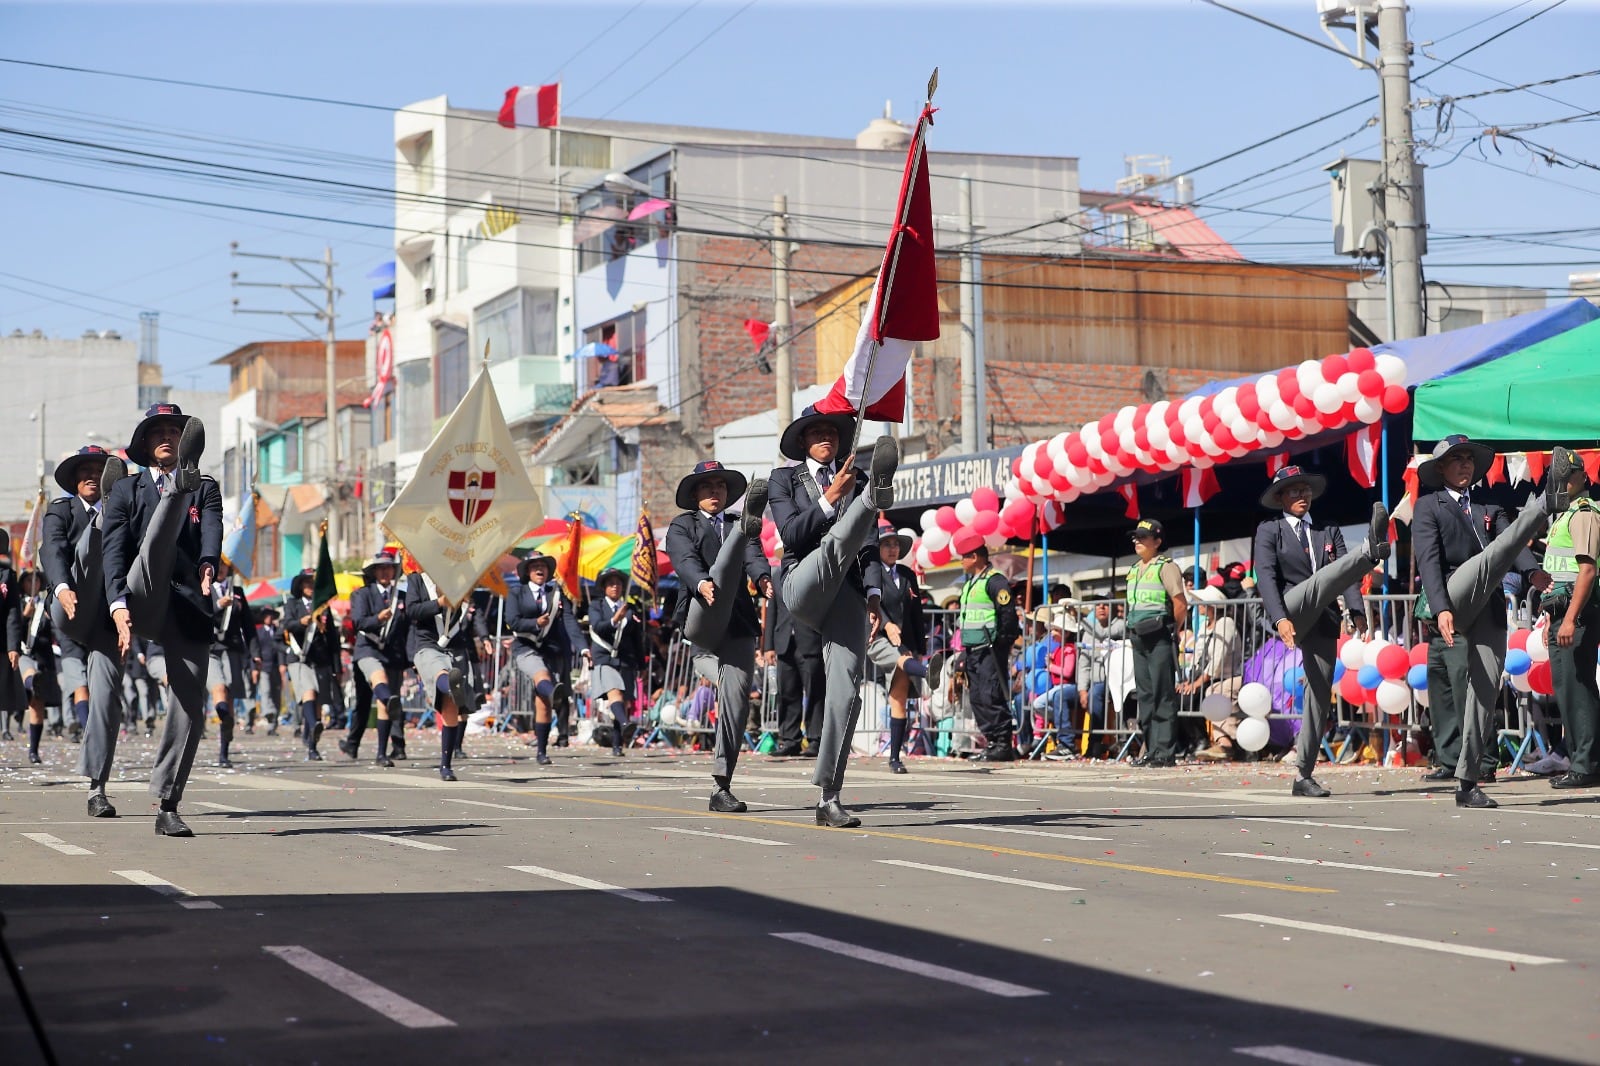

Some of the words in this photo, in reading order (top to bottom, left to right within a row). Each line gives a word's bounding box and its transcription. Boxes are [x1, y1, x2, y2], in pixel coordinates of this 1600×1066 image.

[917, 466, 932, 500] FE
[933, 464, 942, 498] Y
[944, 458, 994, 497] ALEGRIA
